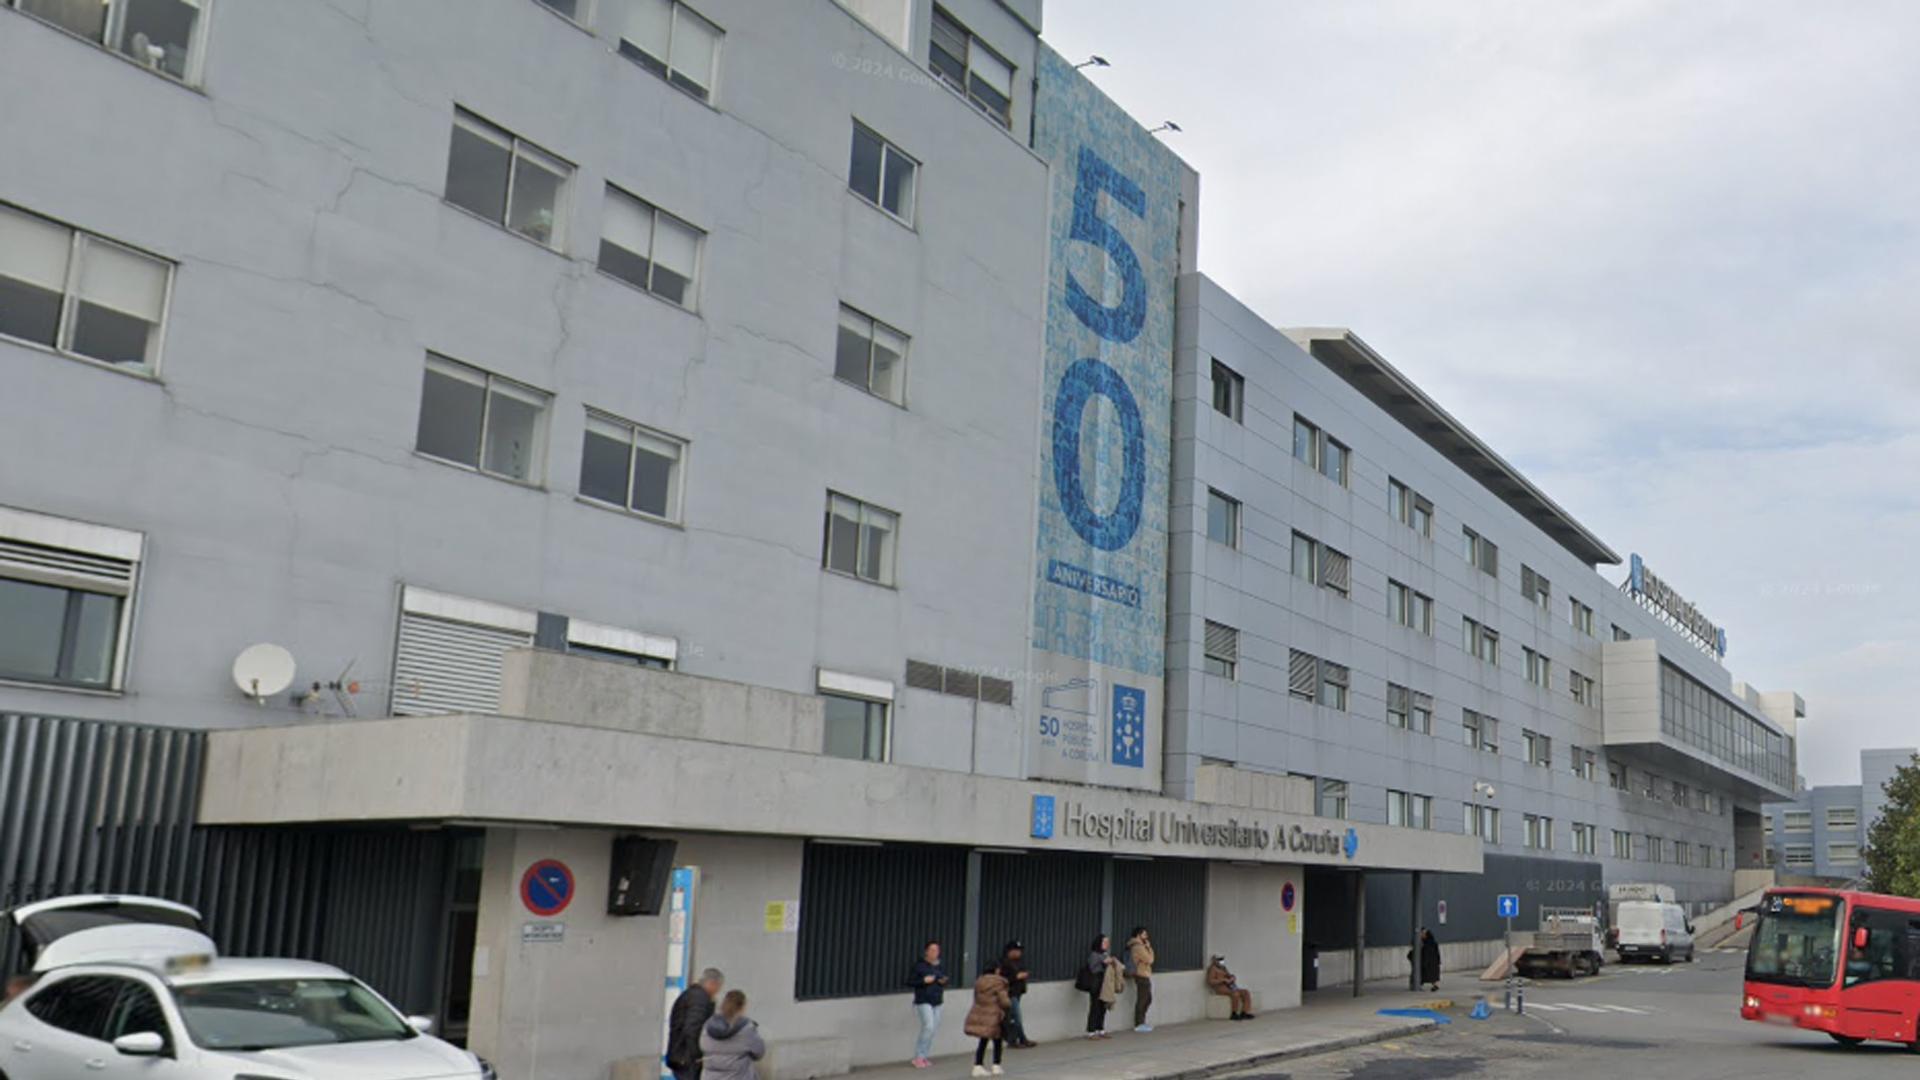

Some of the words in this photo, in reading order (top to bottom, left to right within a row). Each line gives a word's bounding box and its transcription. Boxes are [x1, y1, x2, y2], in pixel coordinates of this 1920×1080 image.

[1052, 145, 1148, 552] 50
[1053, 564, 1141, 606] ANIVERSARIO
[1039, 714, 1060, 738] 50
[1063, 801, 1154, 847] Hospital
[1159, 811, 1269, 850] Universitario
[1273, 823, 1287, 850] A
[1289, 824, 1340, 855] Coruña
